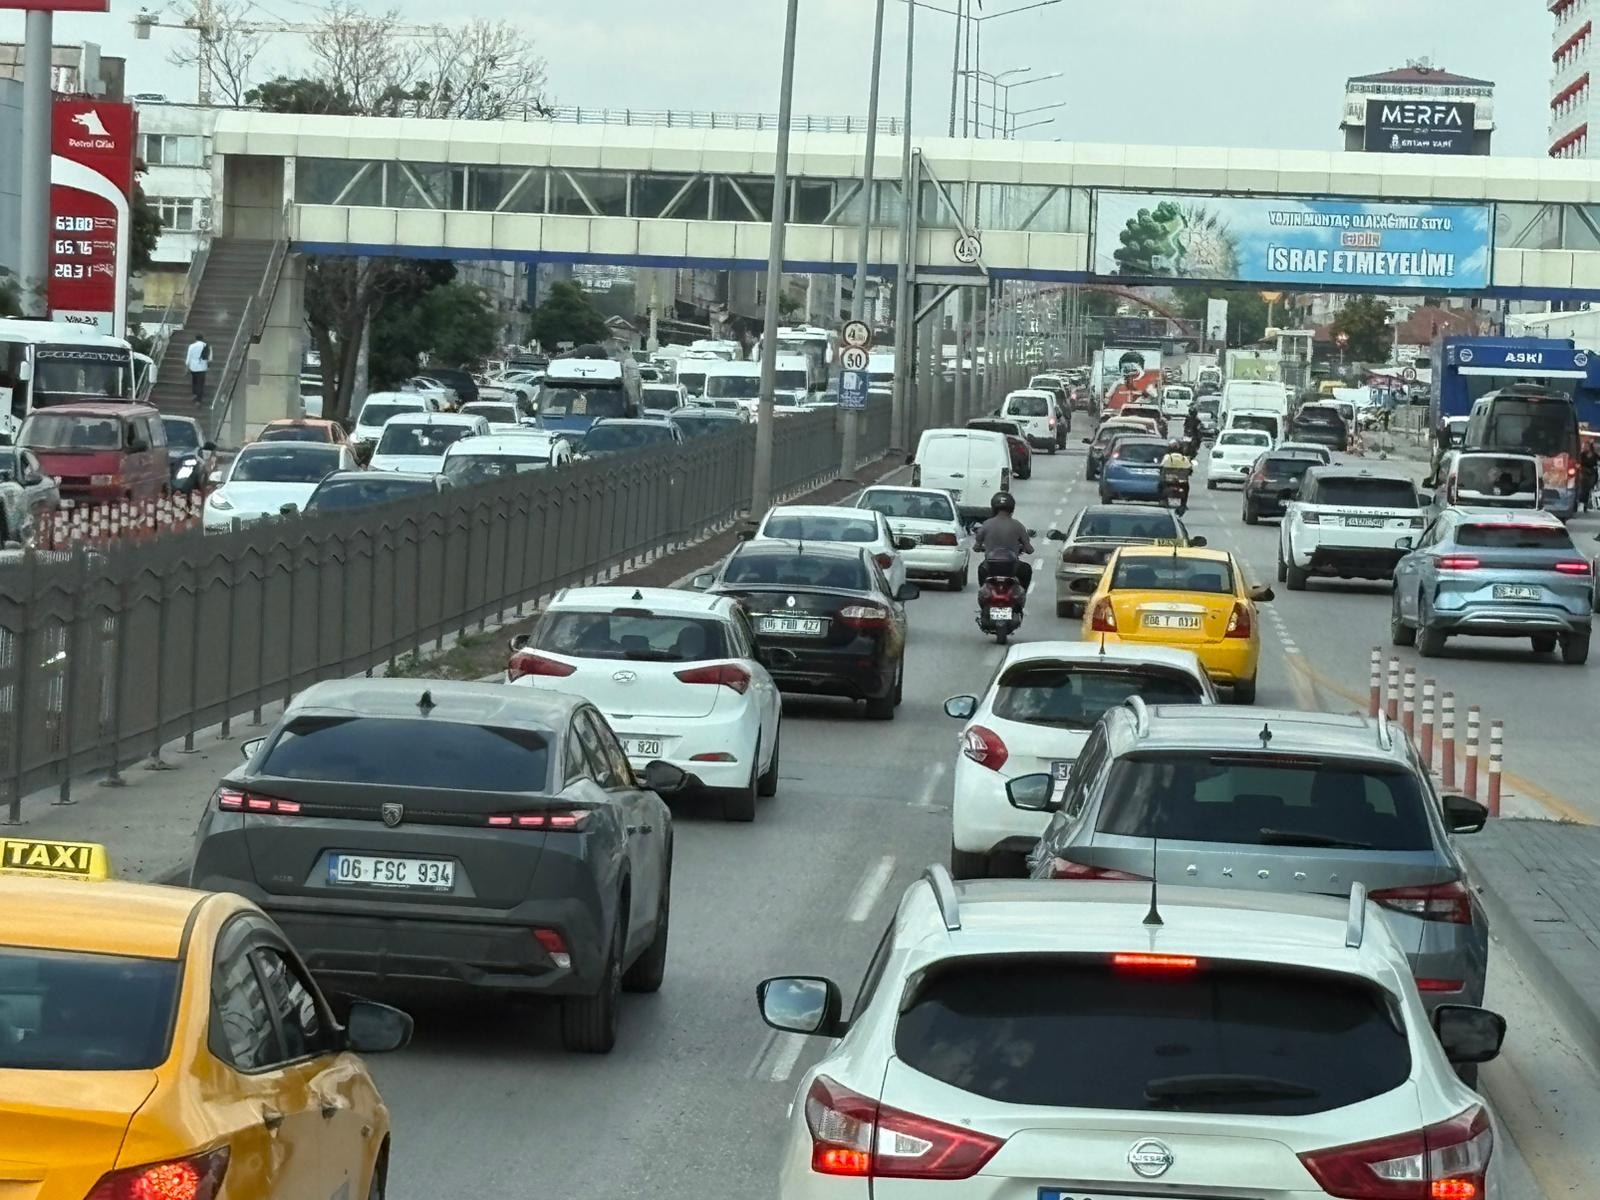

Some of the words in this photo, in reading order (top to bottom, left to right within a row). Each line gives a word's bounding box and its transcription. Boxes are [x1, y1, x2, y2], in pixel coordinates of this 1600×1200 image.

[1381, 104, 1463, 126] MERFA
[1267, 243, 1329, 273] İSRAF
[1332, 249, 1455, 276] ETMEYELİM!
[847, 353, 862, 368] 50
[7, 842, 89, 869] TAXI
[340, 858, 362, 879] 06
[372, 859, 407, 882] FSC
[417, 863, 451, 885] 934
